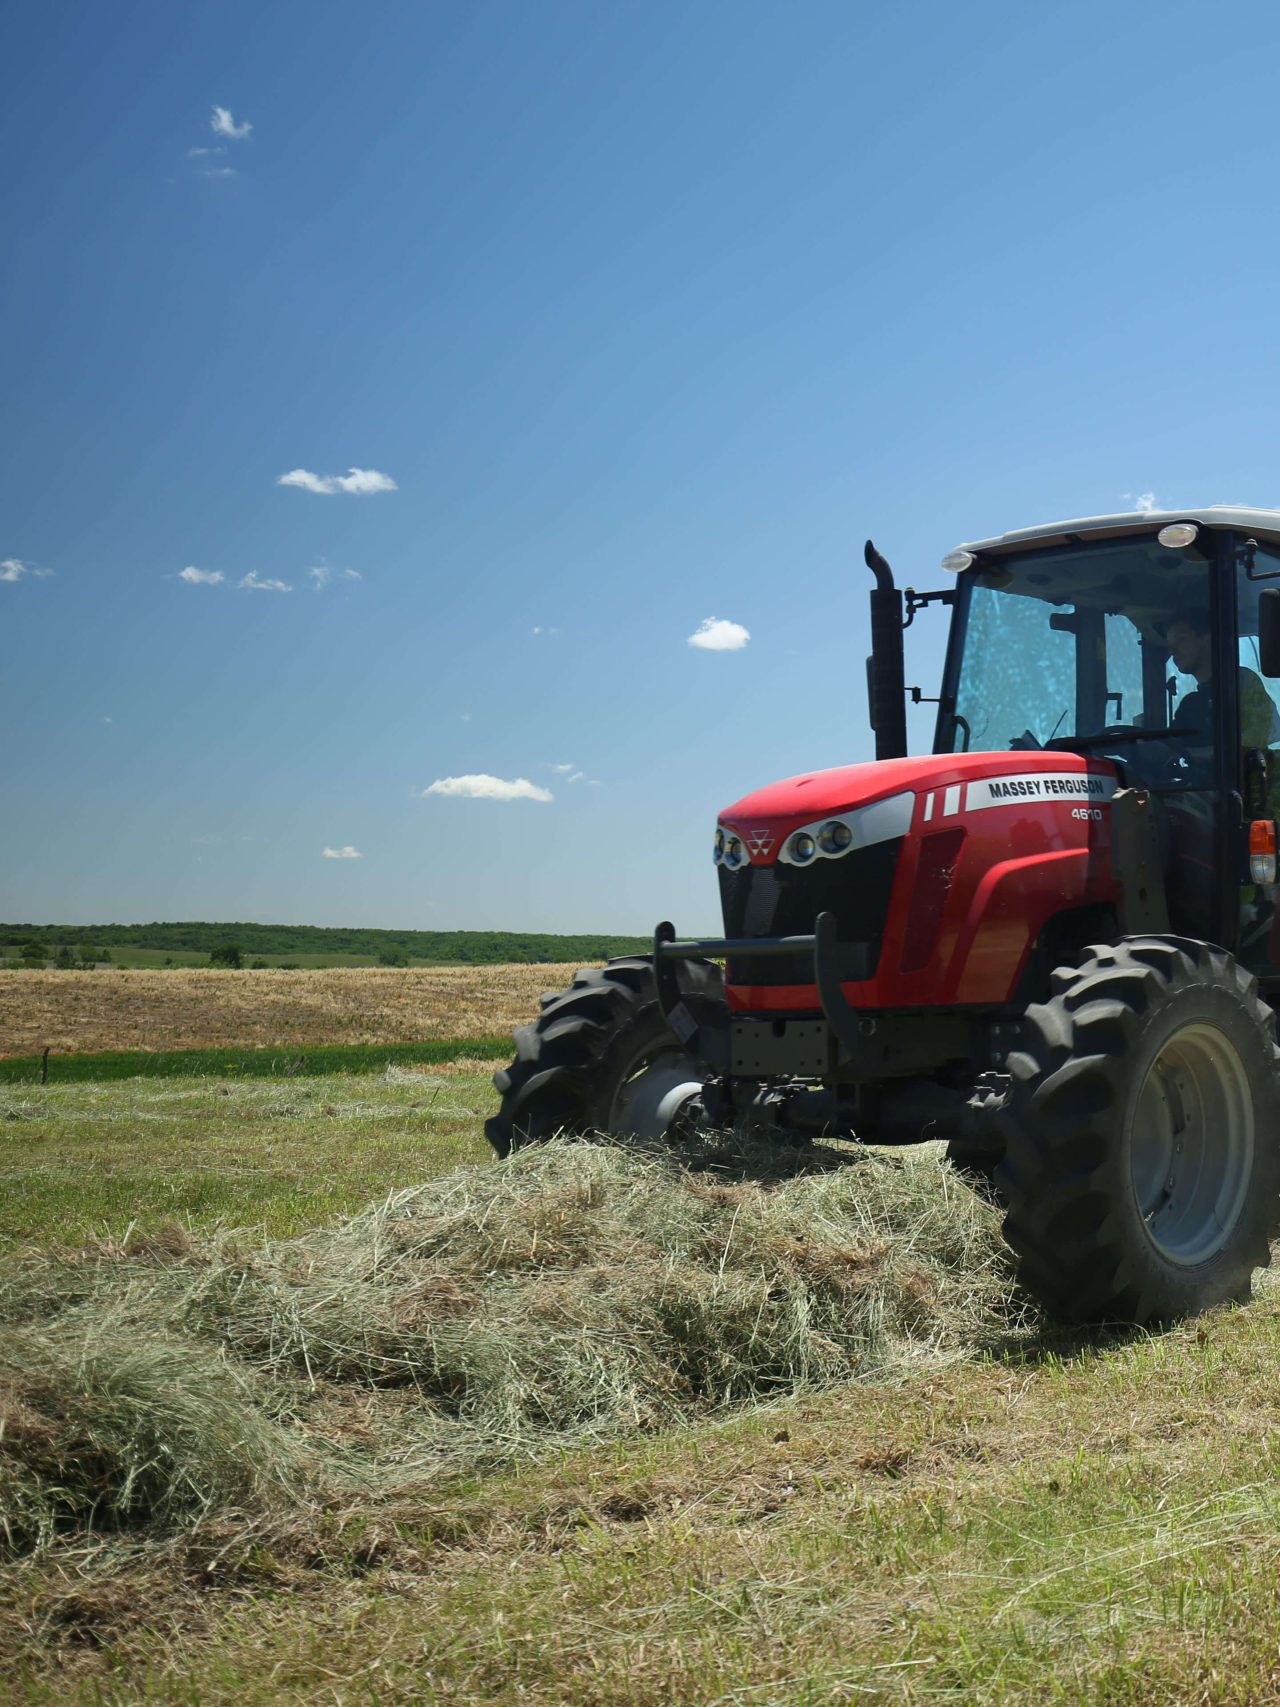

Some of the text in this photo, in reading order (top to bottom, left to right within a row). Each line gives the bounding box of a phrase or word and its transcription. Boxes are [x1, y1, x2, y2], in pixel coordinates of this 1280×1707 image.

[988, 779, 1104, 798] MASSEY FERGUSON
[1071, 808, 1103, 820] 4610
